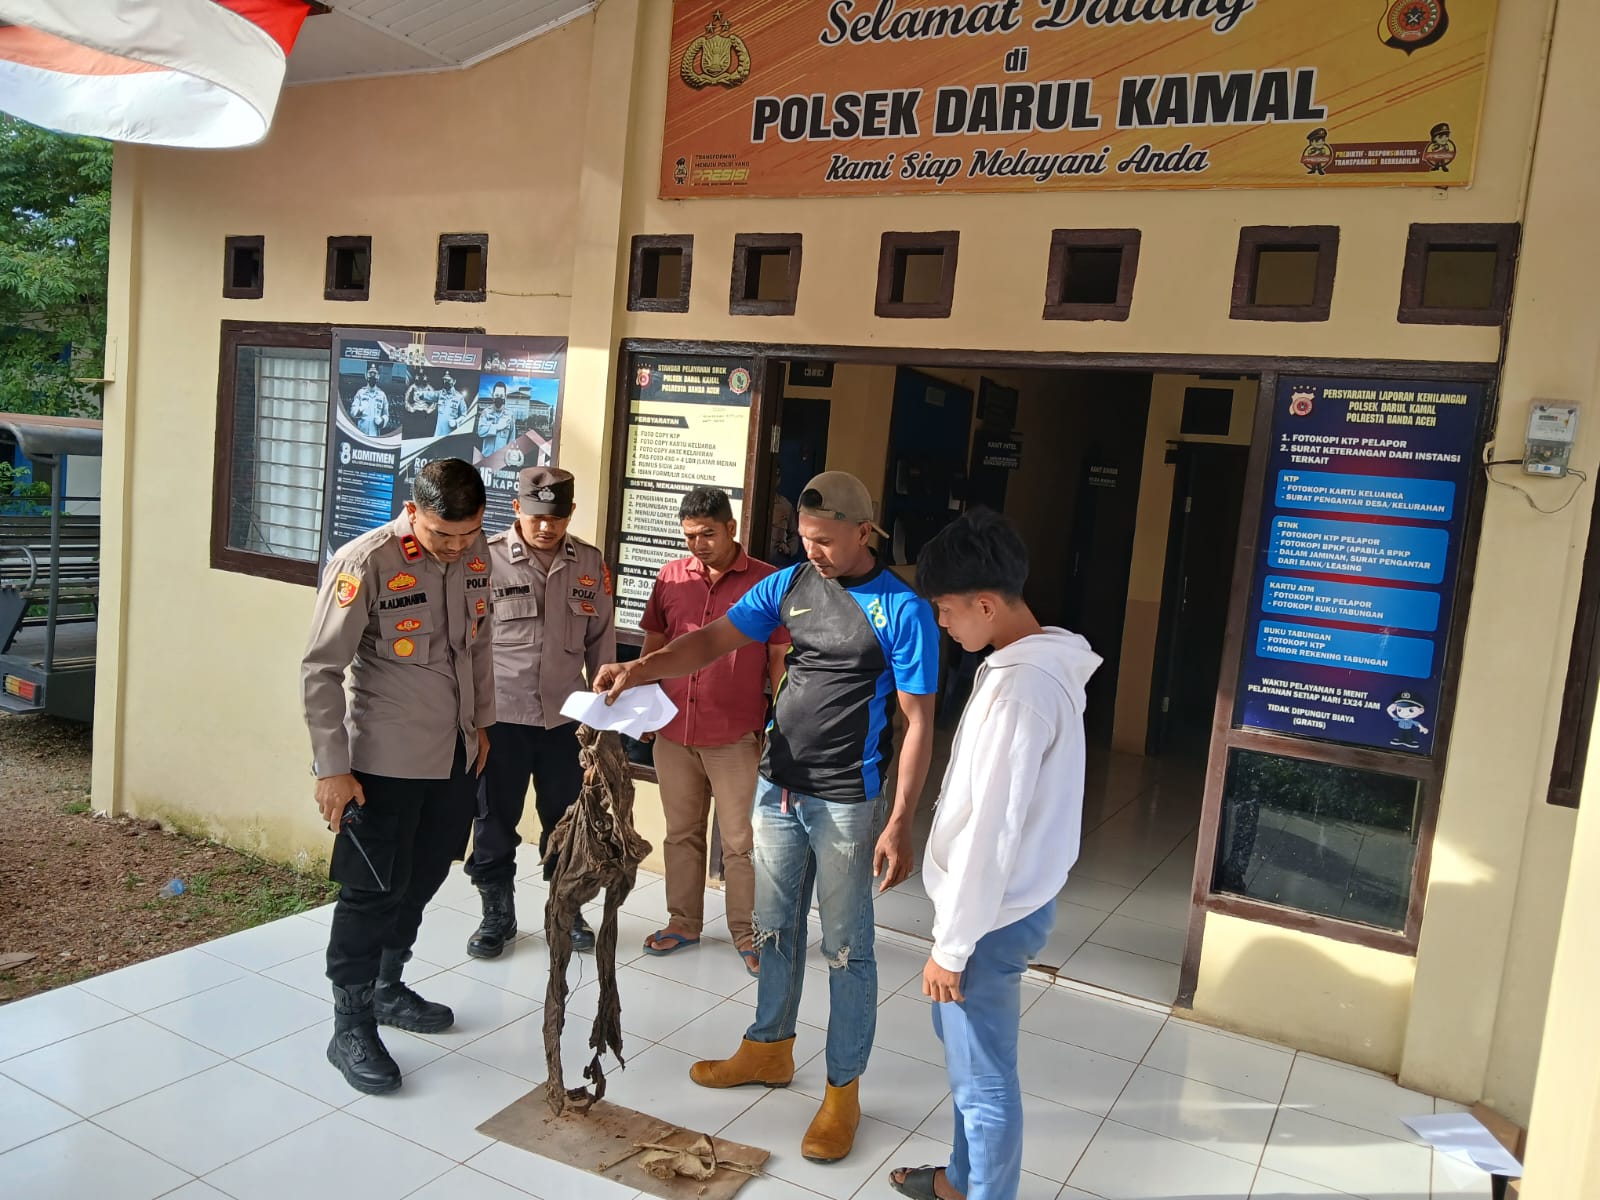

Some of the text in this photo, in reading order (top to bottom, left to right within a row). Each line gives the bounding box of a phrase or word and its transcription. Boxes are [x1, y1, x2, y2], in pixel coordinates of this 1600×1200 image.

[820, 0, 1022, 43] Selamat
[1004, 47, 1030, 72] di
[752, 68, 1327, 141] POLSEK DARUL KAMAL
[824, 143, 1209, 184] Kami Siap Melayani Anda
[345, 347, 380, 357] PRESISI
[431, 351, 477, 363] PRESISI
[507, 359, 558, 370] PRESISI
[1323, 388, 1467, 404] PERSYARATAN LAPORAN KEHILANGAN
[1349, 401, 1437, 415] POLSEK DARUL KAMAL
[635, 416, 679, 425] PERSYARATAN
[1346, 412, 1437, 427] POLRESTA BANDA ACEH
[1281, 434, 1408, 448] 1. FOTOKOPI KTP PELAPOR
[340, 442, 351, 465] 8
[352, 449, 395, 465] KOMITMEN
[1279, 444, 1461, 463] 2. SURAT KETERANGAN DARI INSTANSI
[1291, 455, 1330, 465] TERKAIT
[1287, 484, 1404, 500] FOTOKOPI KARTU KELUARGA
[1286, 493, 1446, 513] SURAT PENGANTAR DESA/KELURAHAN
[1277, 521, 1299, 529] STNK
[626, 535, 676, 546] JANGKA WAKTU
[1281, 530, 1380, 546] FOTOKOPI KTP PELAPOR
[1280, 539, 1321, 549] FOTOKOPI
[1322, 542, 1344, 551] BPKP
[1387, 549, 1411, 558] BPKP
[1277, 557, 1362, 572] DARI BANK/LEASING
[1279, 548, 1308, 557] DALAM
[1350, 555, 1377, 564] SURAT
[1379, 557, 1431, 569] PENGANTAR
[623, 566, 641, 575] BIAYA
[622, 577, 636, 588] RP.
[1269, 582, 1315, 593] KARTU ATM
[572, 588, 598, 599] POLRI
[1273, 591, 1372, 609] FOTOKOPI KTP PELAPOR
[1272, 600, 1384, 619] FOTOKOPI BUKU TABUNGAN
[1263, 627, 1332, 641] BUKU TABUNGAN
[1268, 637, 1326, 650] FOTOKOPI KTP
[1266, 645, 1388, 667] NOMOR REKENING TABUNGAN
[1262, 677, 1289, 688] WAKTU
[1289, 681, 1335, 694] PELAYANAN
[1343, 690, 1368, 700] MENIT
[1247, 684, 1381, 710] PELAYANAN SETIAP HARI 1X24 JAM
[1267, 703, 1355, 723] TIDAK DIPUNGUT BIAYA
[1292, 717, 1327, 730] (GRATIS)
